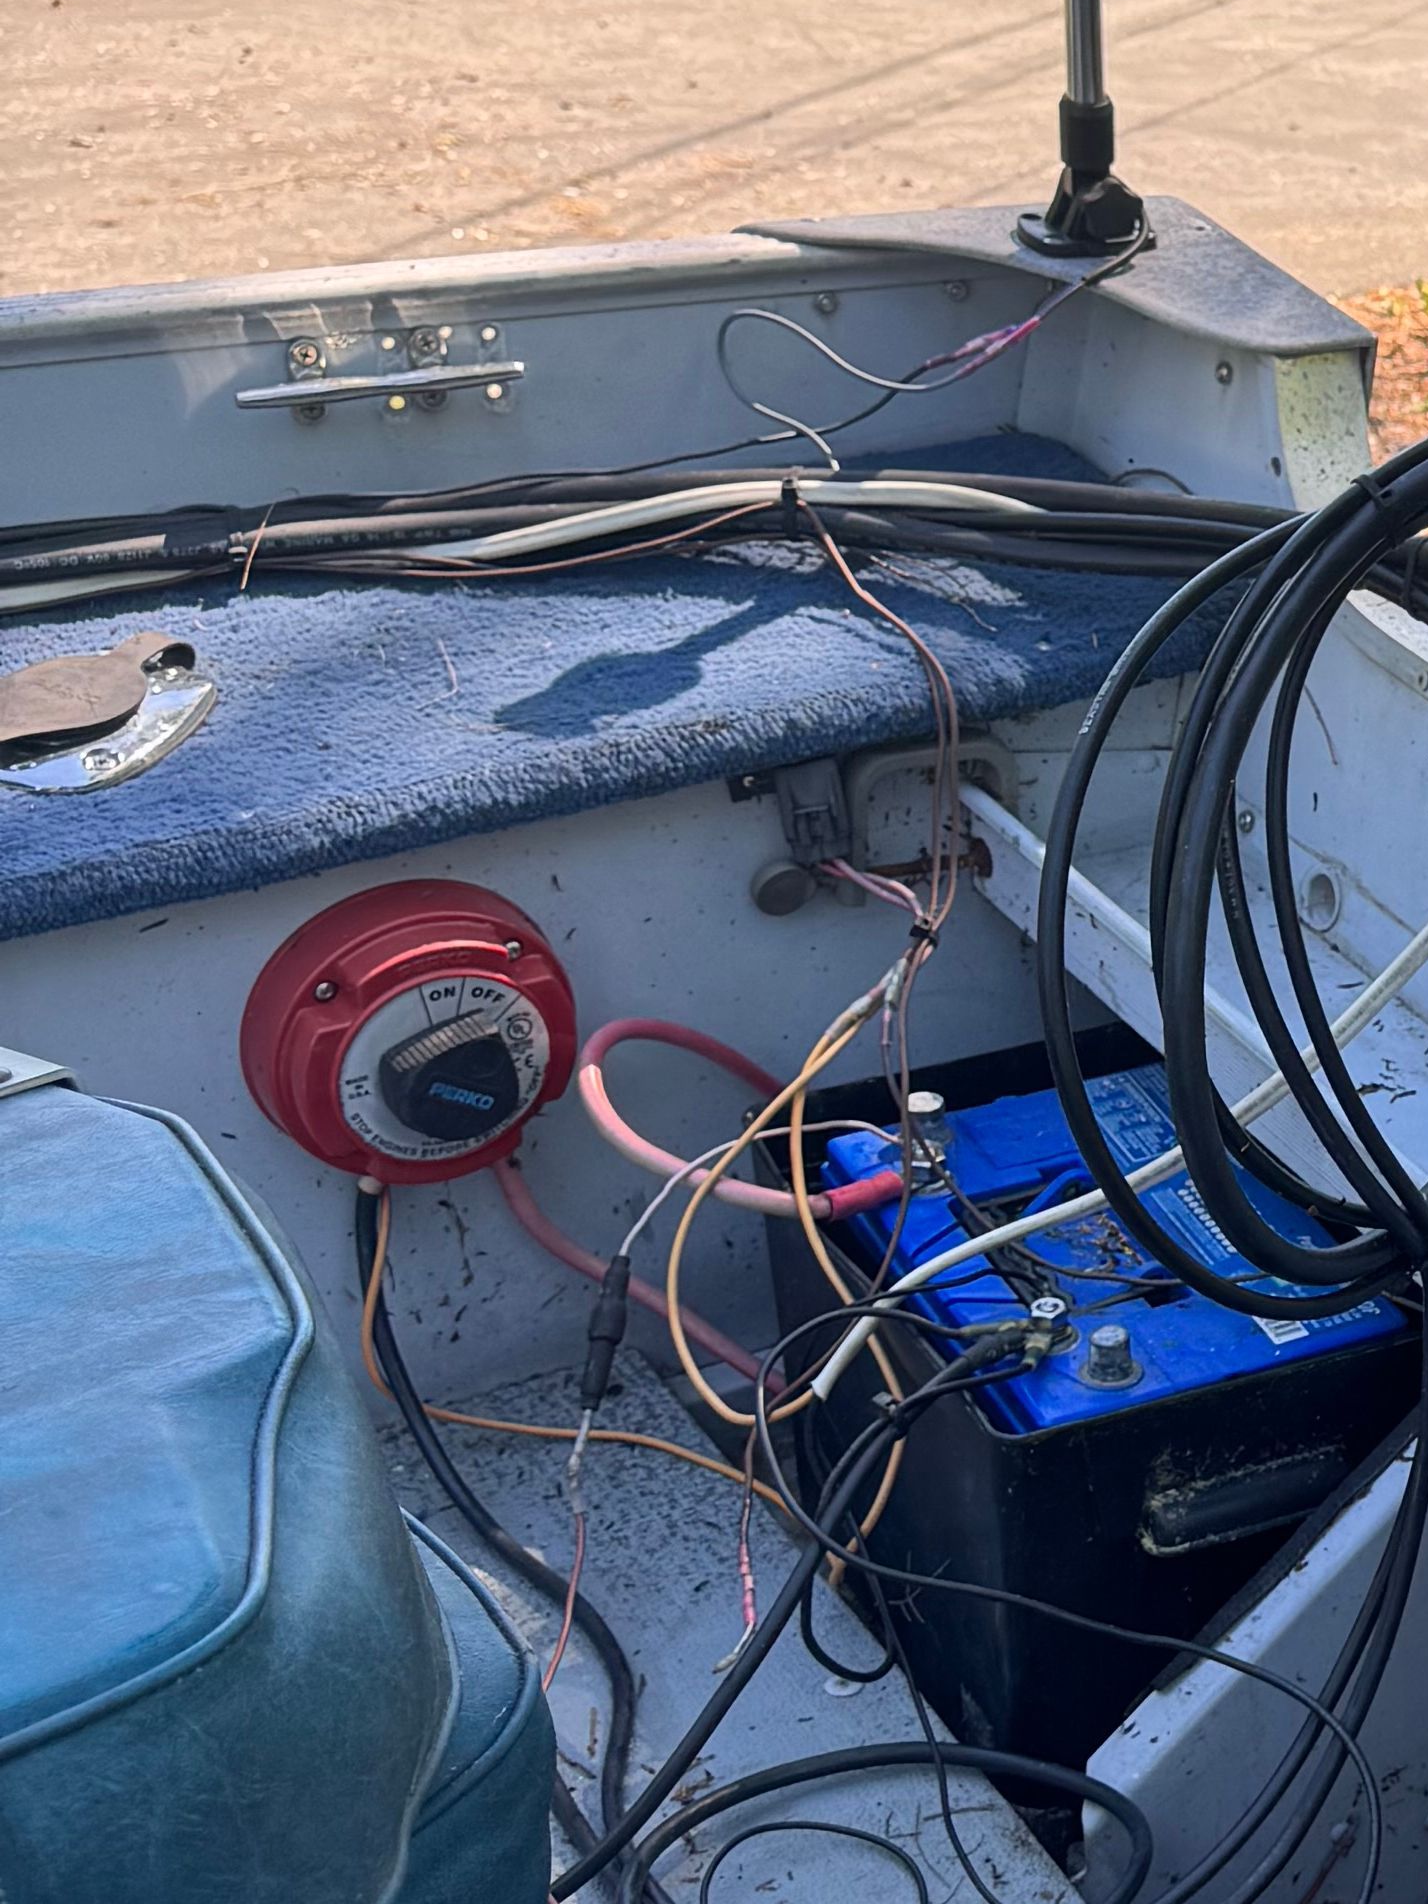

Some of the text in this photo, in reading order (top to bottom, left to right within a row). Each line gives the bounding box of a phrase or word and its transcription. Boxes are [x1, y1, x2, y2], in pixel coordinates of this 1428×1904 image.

[429, 986, 456, 1002] ON
[471, 986, 506, 1004] OFF
[429, 1081, 495, 1111] PERKO
[351, 1112, 374, 1135] STOP
[371, 1133, 418, 1157] ENGINES
[420, 1138, 469, 1159] BEFORE
